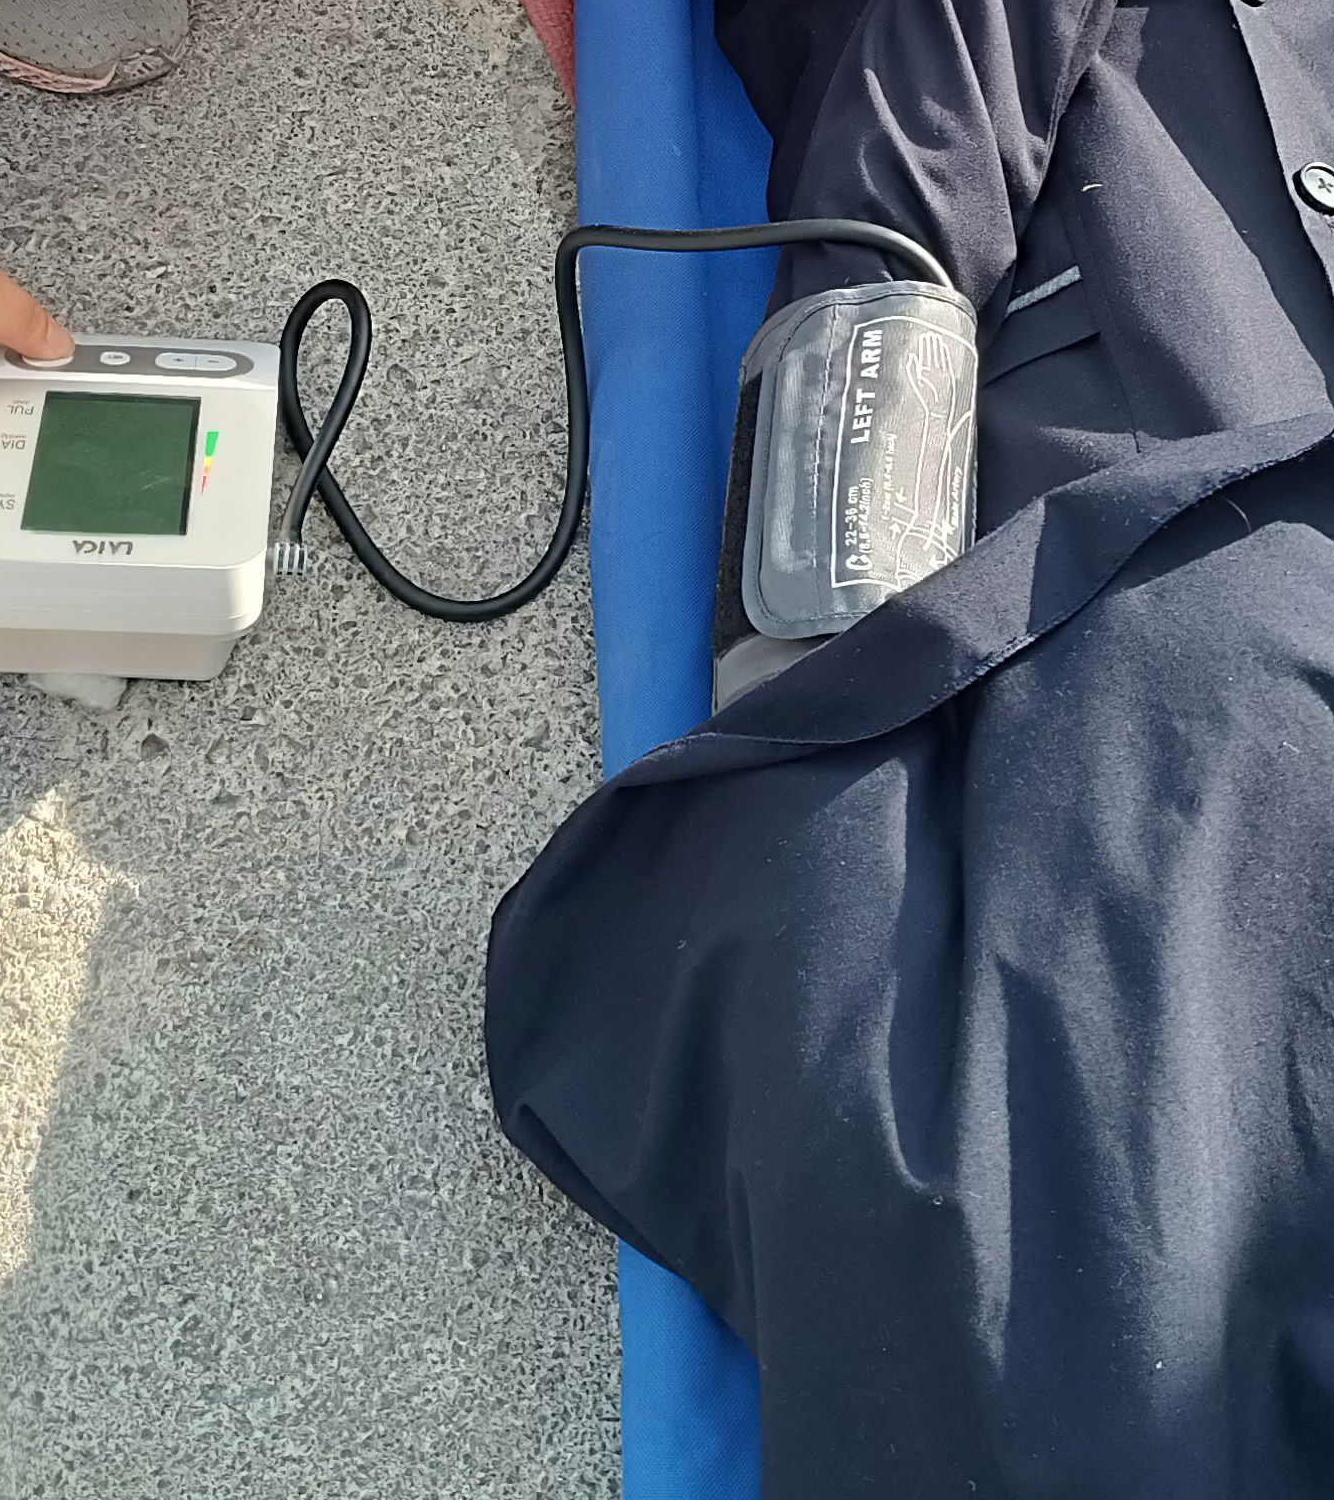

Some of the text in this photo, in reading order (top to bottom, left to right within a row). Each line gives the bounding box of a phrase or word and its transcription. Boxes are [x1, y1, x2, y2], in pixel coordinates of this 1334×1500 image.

[851, 329, 883, 444] LEFT ARM
[6, 404, 35, 416] PUL
[0, 439, 27, 450] DIA
[844, 485, 859, 547] 22-36 cm
[72, 539, 134, 556] LAICA
